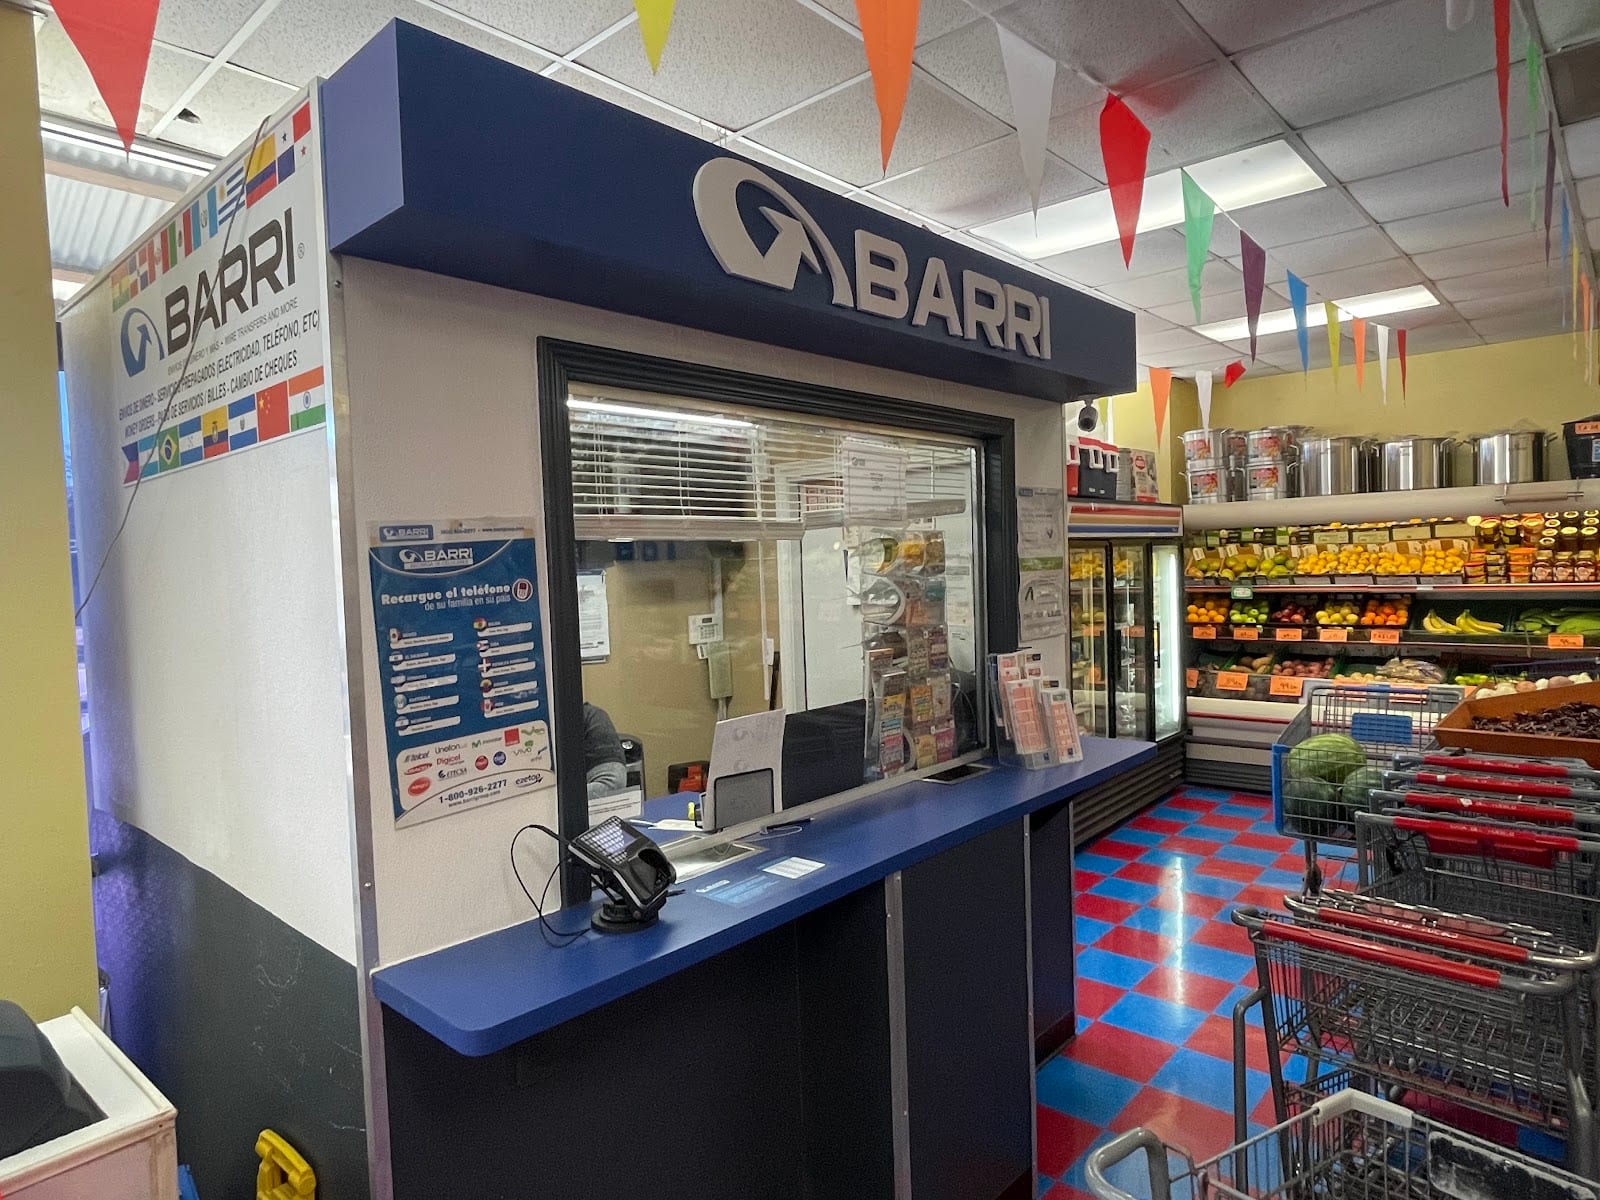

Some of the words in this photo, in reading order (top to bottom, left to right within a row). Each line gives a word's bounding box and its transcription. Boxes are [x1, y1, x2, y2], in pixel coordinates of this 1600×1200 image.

[165, 207, 296, 356] BARRI
[854, 229, 1051, 360] BARRI
[268, 308, 279, 325] AND
[280, 297, 298, 315] MORE
[183, 362, 216, 392] PREPAGADOS
[216, 338, 261, 378] (ELECTRICIDAD,
[262, 319, 300, 353] TELÉFONO,
[302, 309, 320, 334] ETC)
[178, 392, 204, 416] SERVICIOS
[207, 382, 226, 403] BILLES
[230, 369, 253, 394] CAMBIO
[254, 365, 264, 383] DE
[264, 349, 298, 379] CHEQUES
[398, 527, 429, 536] BARRI
[424, 548, 473, 561] BARRI
[381, 592, 442, 606] Recargue
[445, 588, 457, 598] el
[461, 583, 511, 597] teléfono
[424, 602, 434, 611] de
[447, 596, 473, 608] familia
[475, 597, 484, 605] en
[486, 596, 495, 604] su
[434, 744, 461, 754] Unefon
[436, 753, 461, 765] Digicel
[515, 773, 541, 785] ezetop
[439, 779, 507, 804] 1-800-926-2277
